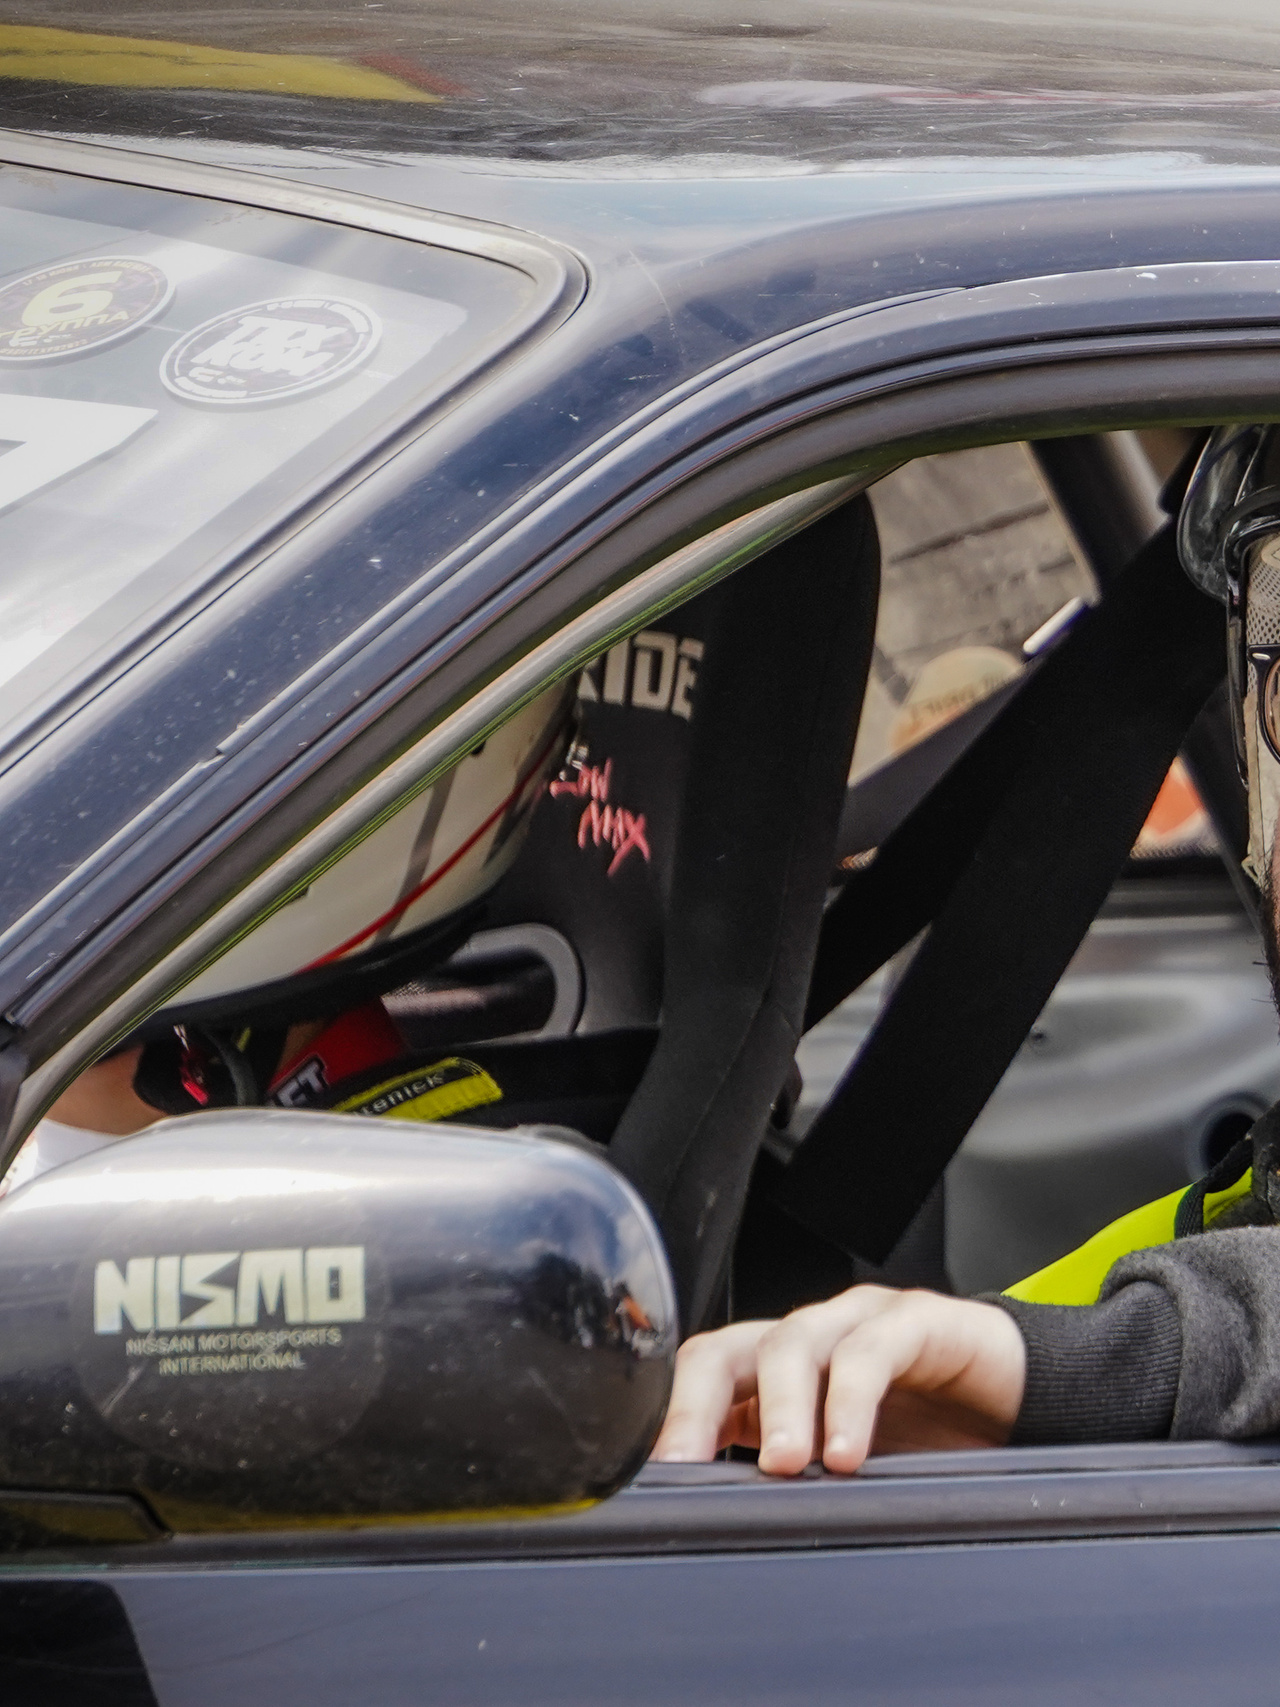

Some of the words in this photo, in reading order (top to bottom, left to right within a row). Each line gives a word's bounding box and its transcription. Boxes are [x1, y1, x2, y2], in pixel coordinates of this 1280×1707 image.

[22, 270, 122, 327] 6
[93, 1245, 366, 1335] NISMO
[125, 1334, 195, 1356] NISSAN
[199, 1327, 343, 1353] MOTORSPORTS
[158, 1351, 306, 1377] INTERNATIONAL
